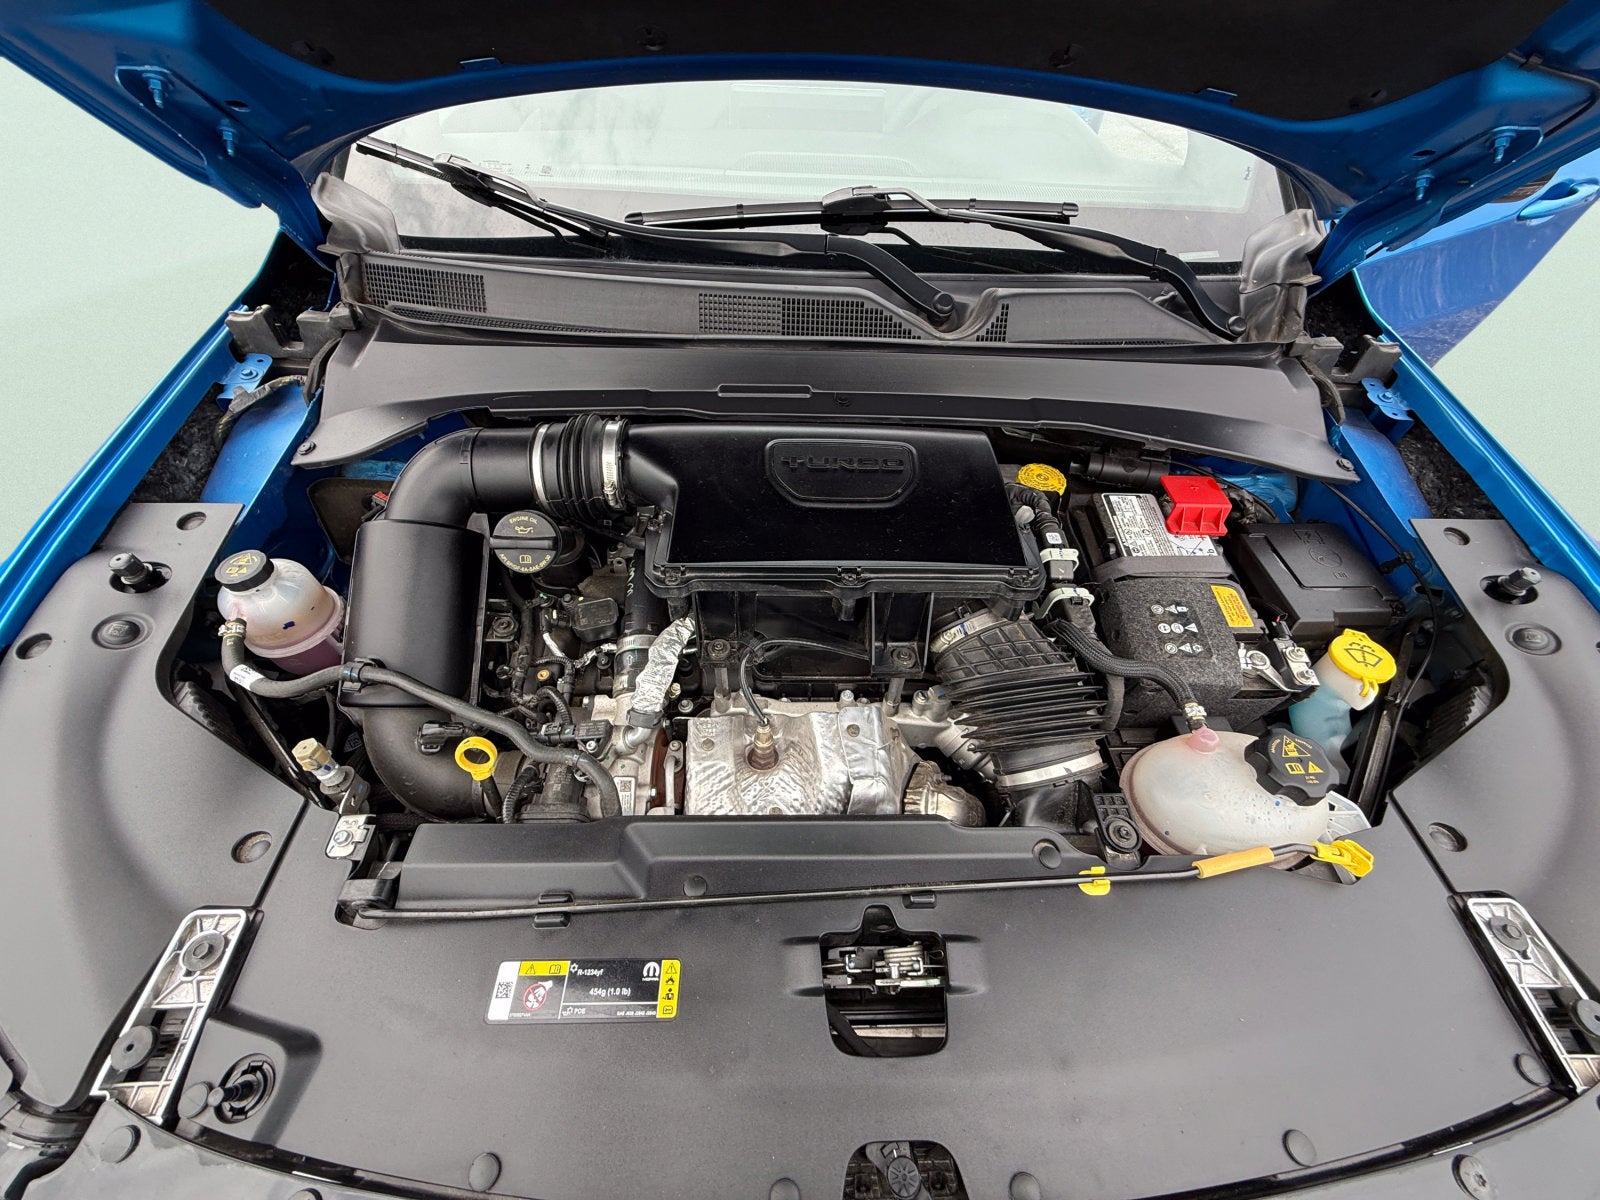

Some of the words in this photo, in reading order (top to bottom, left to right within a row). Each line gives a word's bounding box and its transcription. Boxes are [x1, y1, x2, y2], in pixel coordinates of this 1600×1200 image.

[780, 456, 905, 471] TURBO
[509, 516, 528, 524] ENGINE
[577, 968, 604, 977] R-1234yf
[589, 987, 607, 998] 454g
[607, 987, 621, 998] (1.0
[621, 987, 631, 997] lb)
